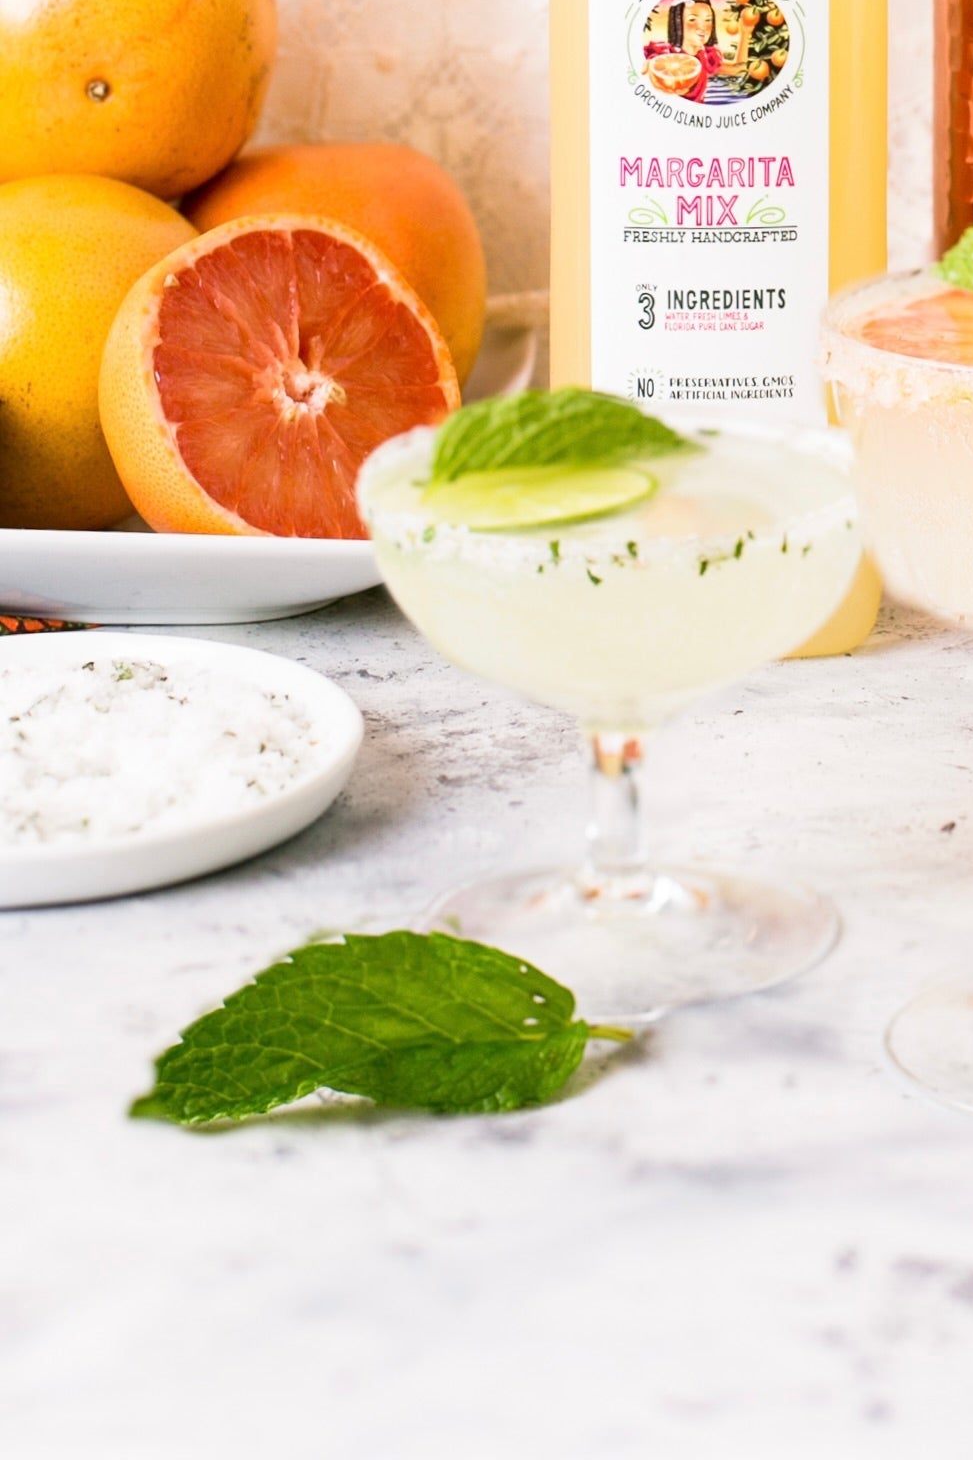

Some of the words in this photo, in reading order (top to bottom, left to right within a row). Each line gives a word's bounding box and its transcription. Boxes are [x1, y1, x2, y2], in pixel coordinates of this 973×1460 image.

[634, 84, 673, 119] ORCHID
[673, 110, 712, 128] ISLAND
[716, 112, 747, 128] JUICE
[750, 84, 794, 122] COMPANY
[620, 157, 795, 187] MARGARITA
[677, 195, 739, 226] MIX
[623, 230, 686, 243] FRESHLY
[691, 230, 798, 243] HANDCRAFTED
[635, 284, 658, 292] ONLY
[638, 293, 655, 329] 3
[667, 289, 786, 310] INGREDIENTS
[693, 312, 716, 320] FRESH
[664, 322, 696, 331] FLORIDA
[699, 322, 716, 331] PURE
[719, 322, 737, 331] CANE
[740, 321, 764, 331] SUGAR
[637, 378, 655, 397] NO
[669, 390, 728, 400] ARTIFICIAL
[731, 388, 794, 399] INGREDIENTS
